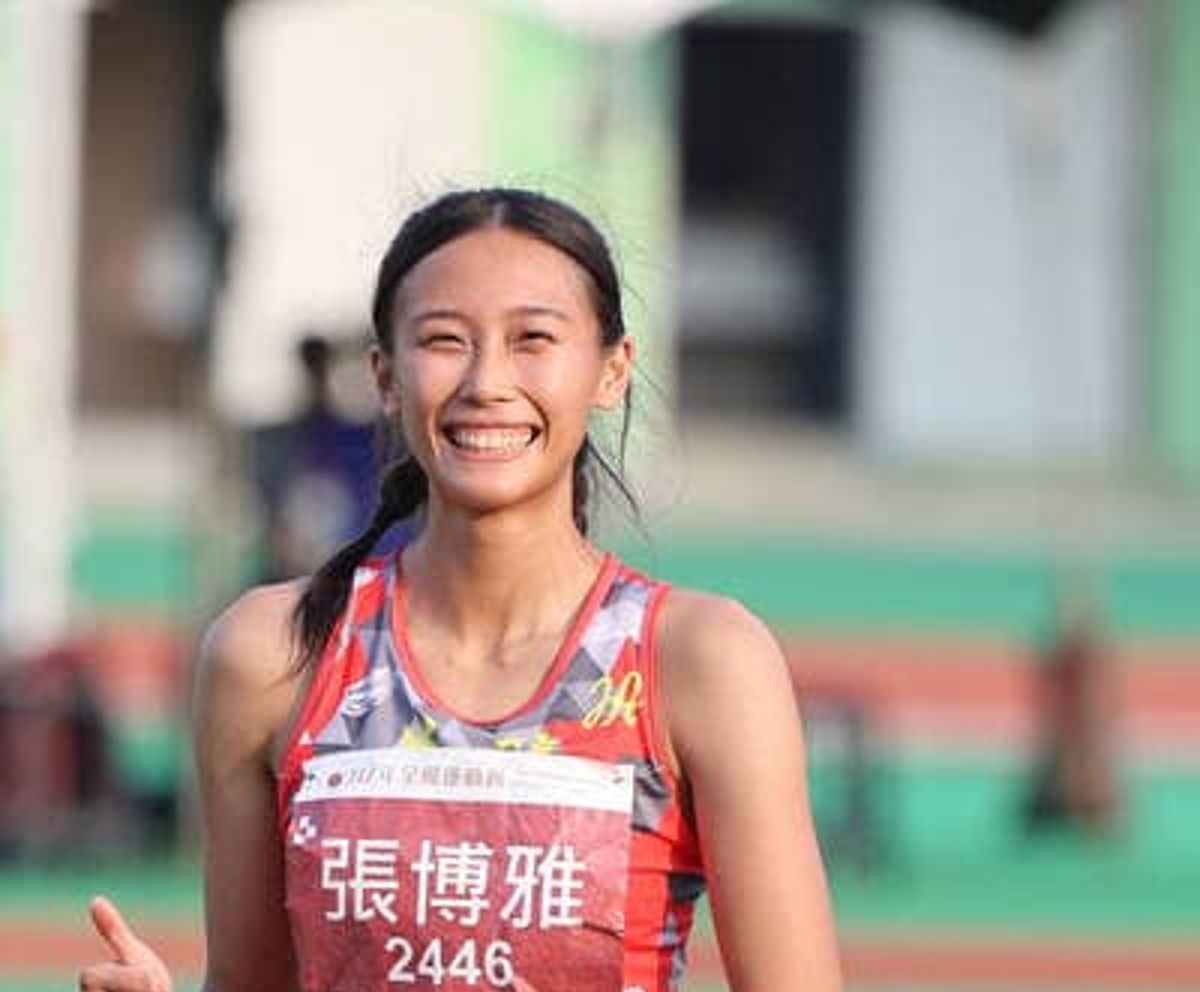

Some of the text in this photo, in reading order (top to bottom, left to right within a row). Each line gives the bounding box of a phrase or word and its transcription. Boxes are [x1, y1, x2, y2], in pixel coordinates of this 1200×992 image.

[320, 838, 587, 929] 張博雅
[384, 937, 514, 986] 2446
